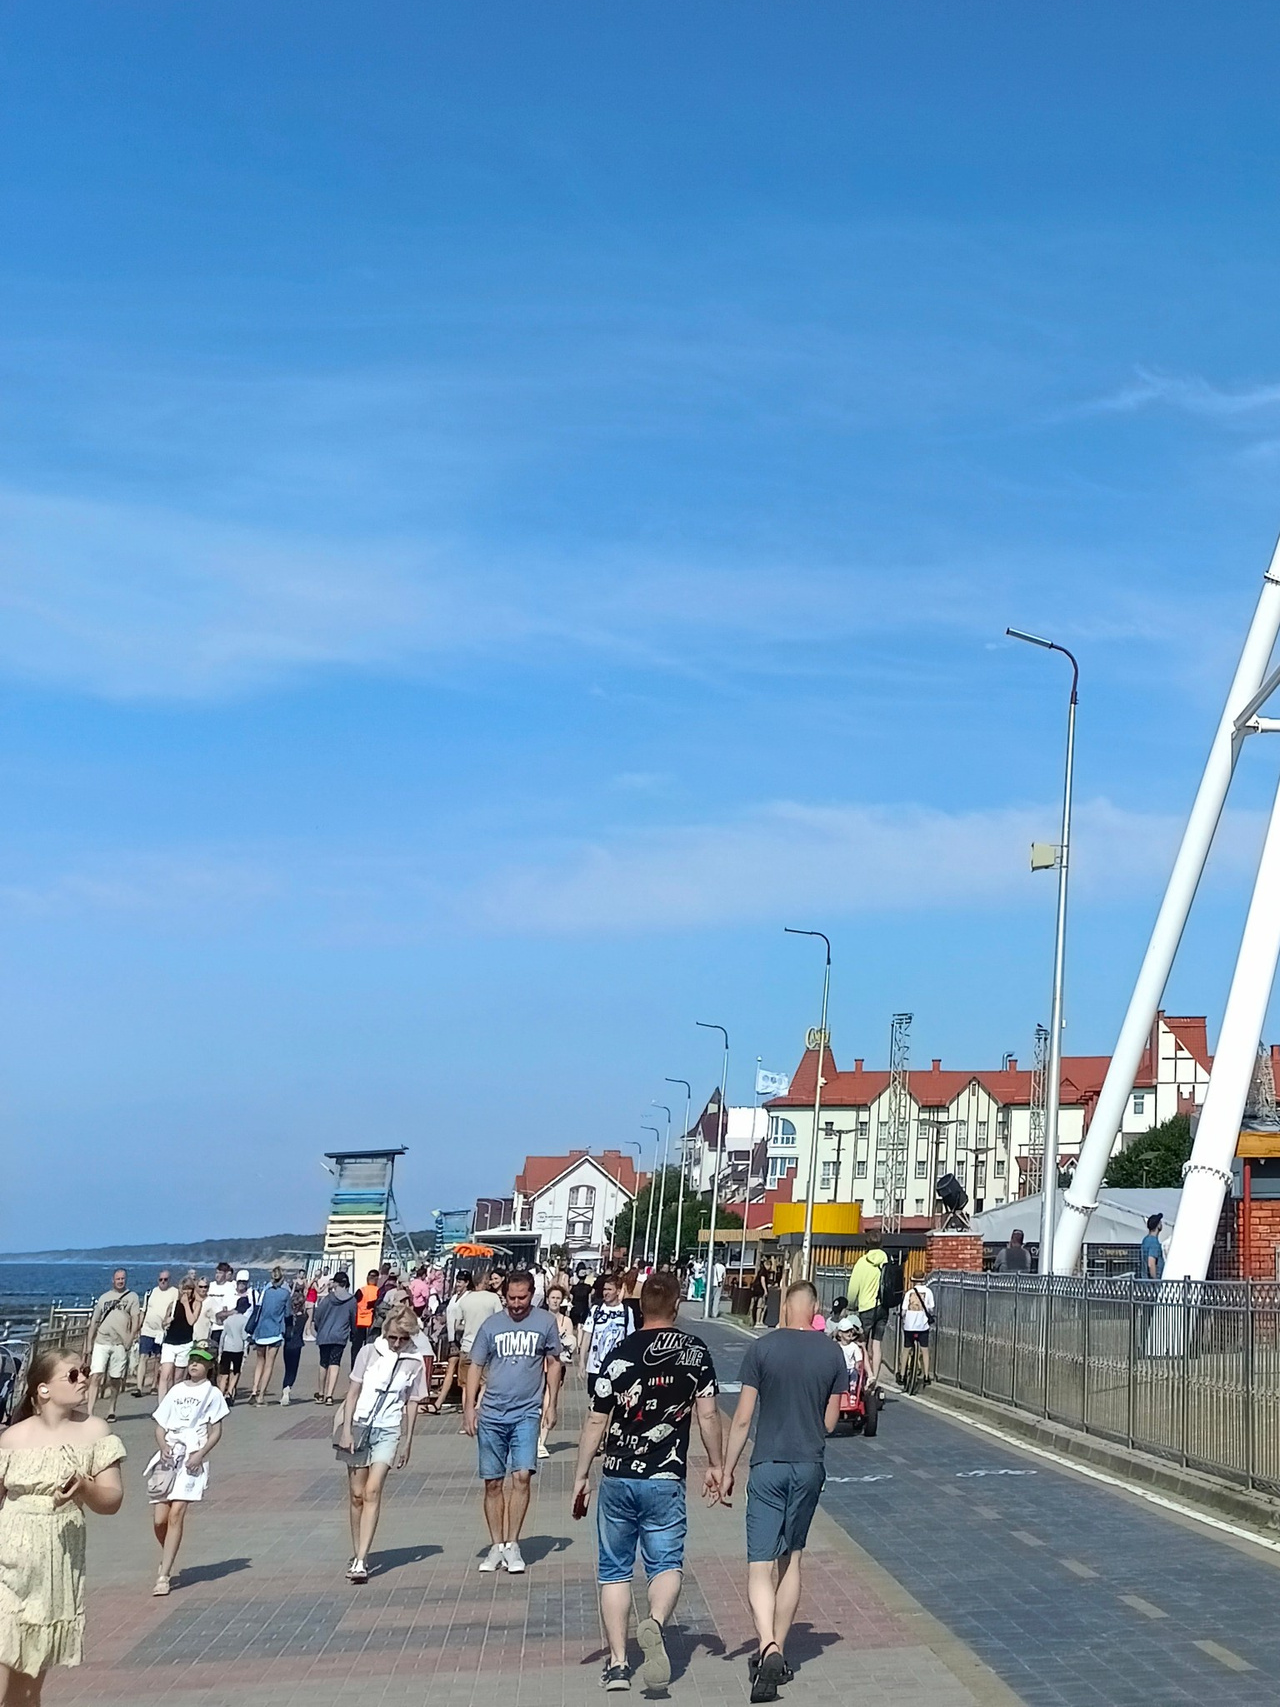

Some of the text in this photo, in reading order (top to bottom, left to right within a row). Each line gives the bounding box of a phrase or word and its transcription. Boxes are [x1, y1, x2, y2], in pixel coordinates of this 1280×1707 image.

[494, 1330, 540, 1358] TOMMY
[675, 1349, 704, 1367] AIR
[645, 1399, 658, 1411] 23
